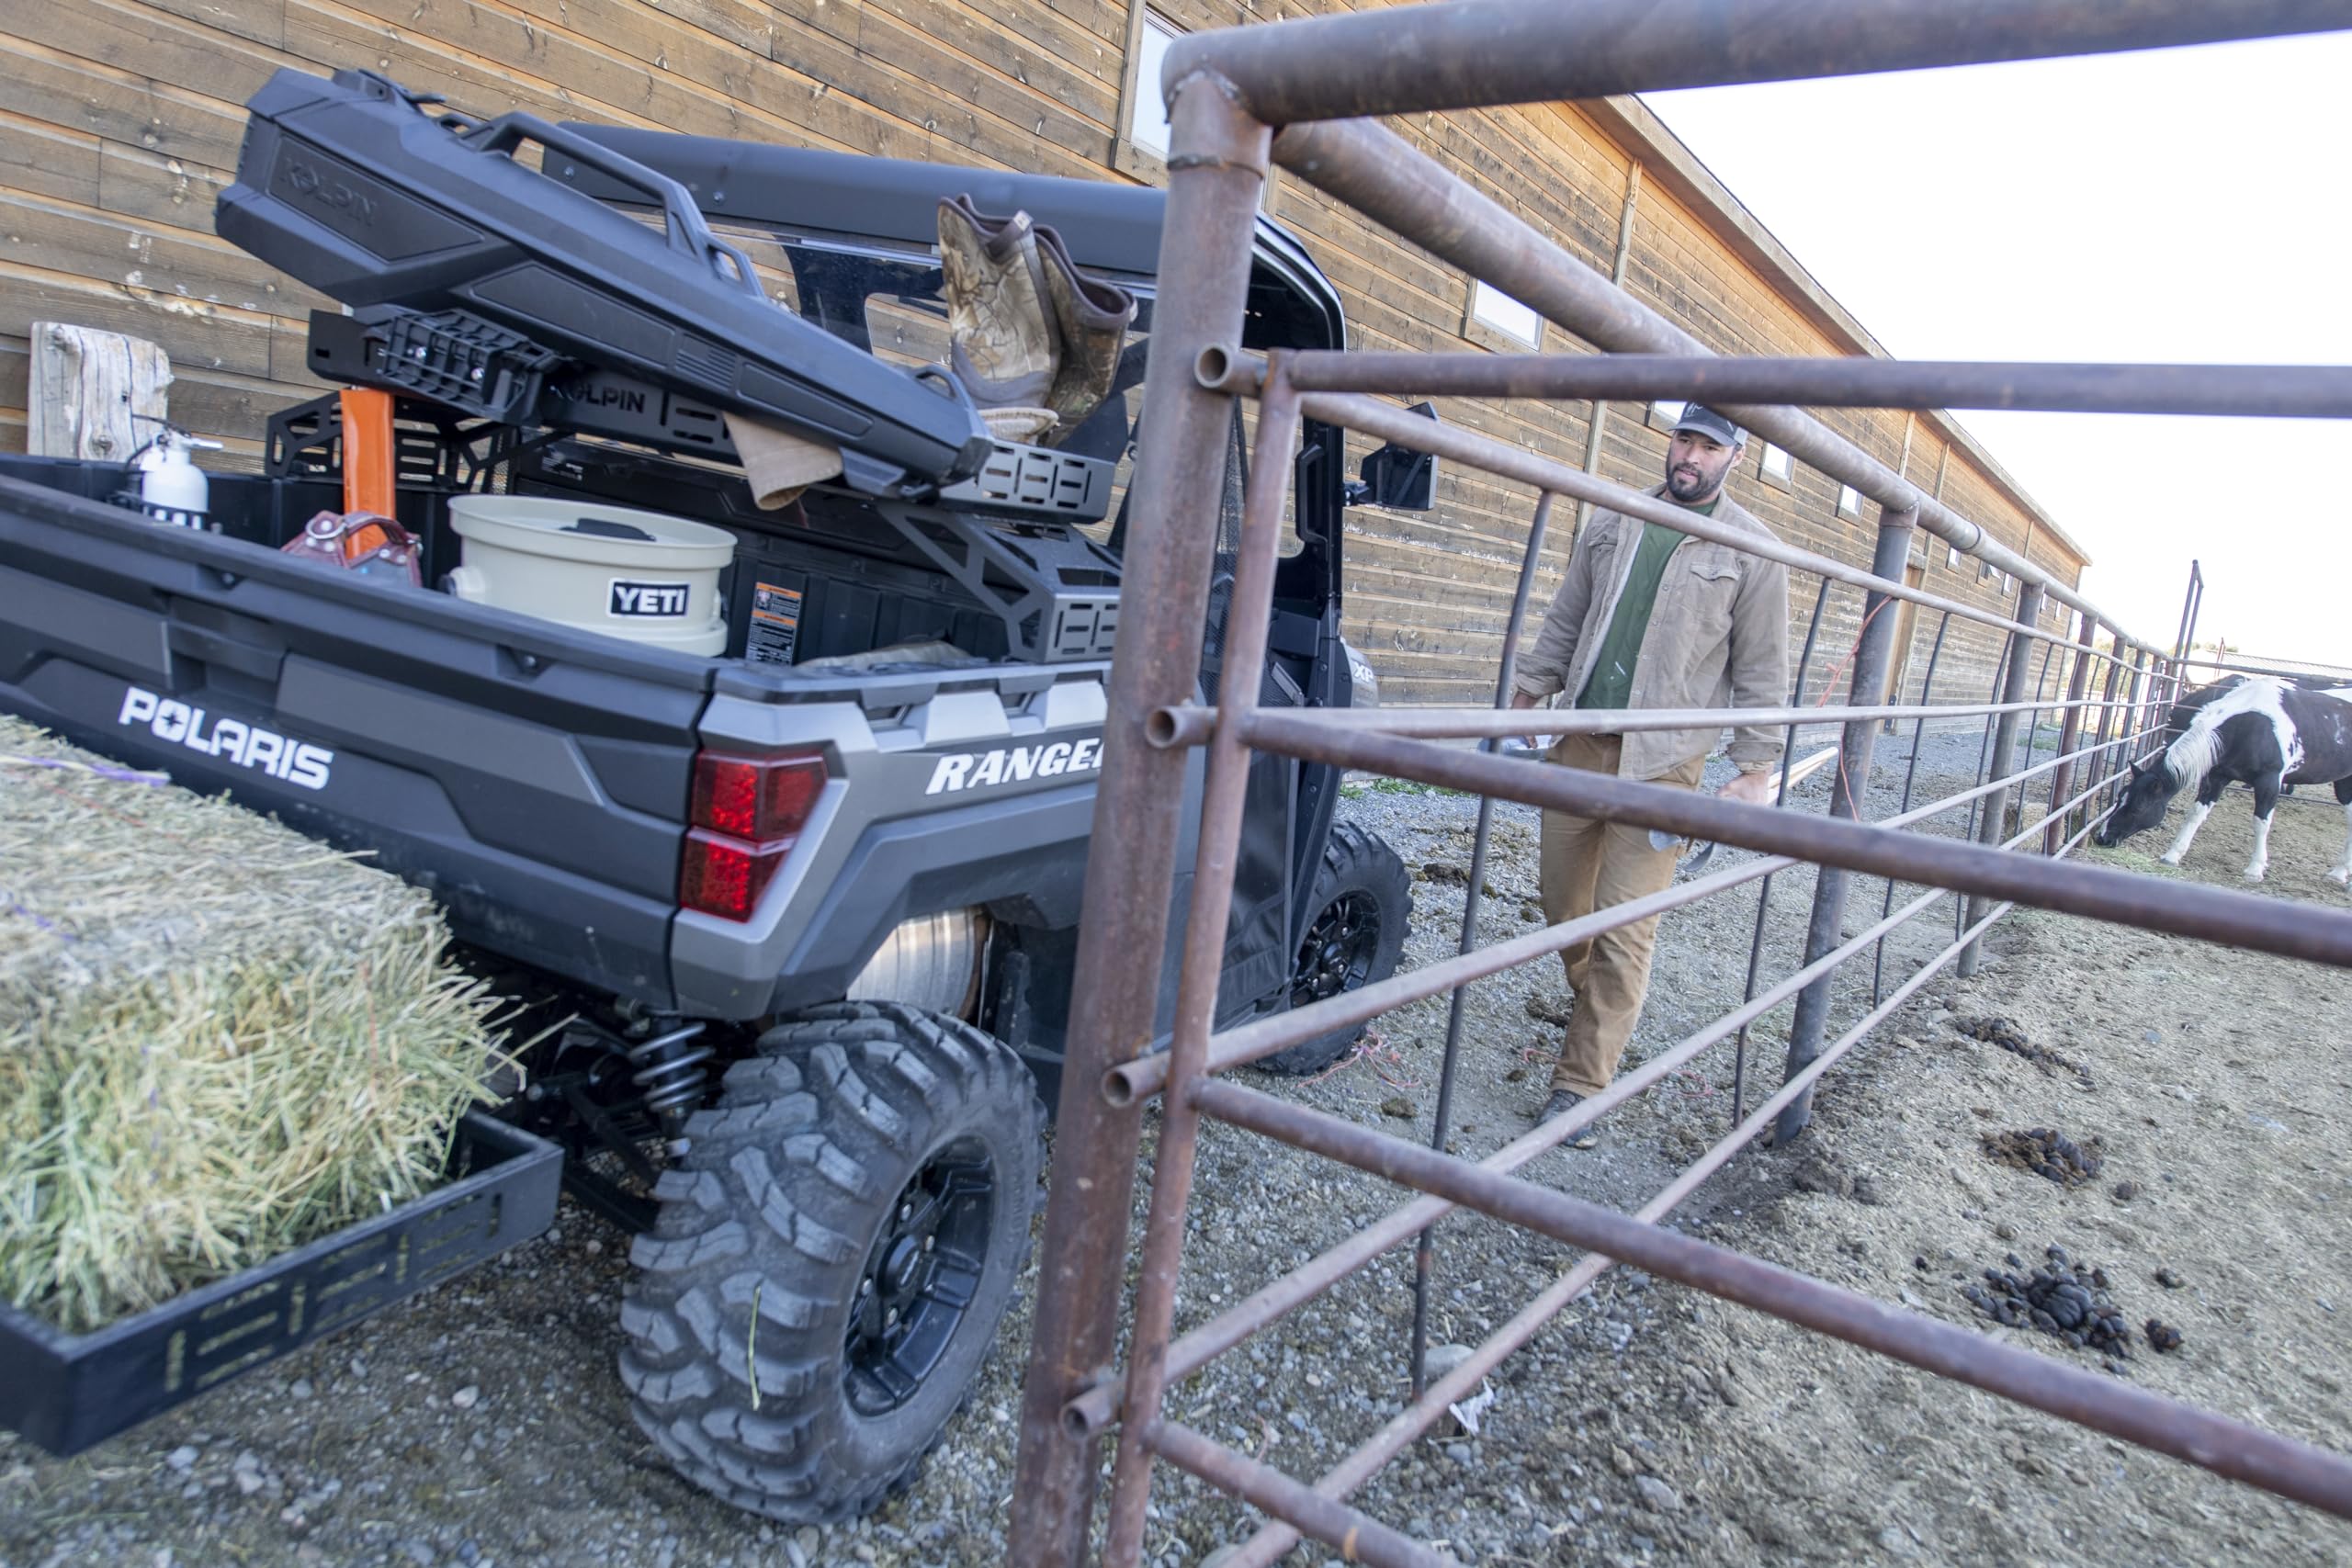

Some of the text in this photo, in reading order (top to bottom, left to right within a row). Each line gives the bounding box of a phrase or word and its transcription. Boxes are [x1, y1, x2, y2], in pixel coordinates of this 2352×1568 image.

[615, 585, 685, 613] YETI
[1353, 661, 1374, 682] XP
[119, 686, 334, 791] POLARIS
